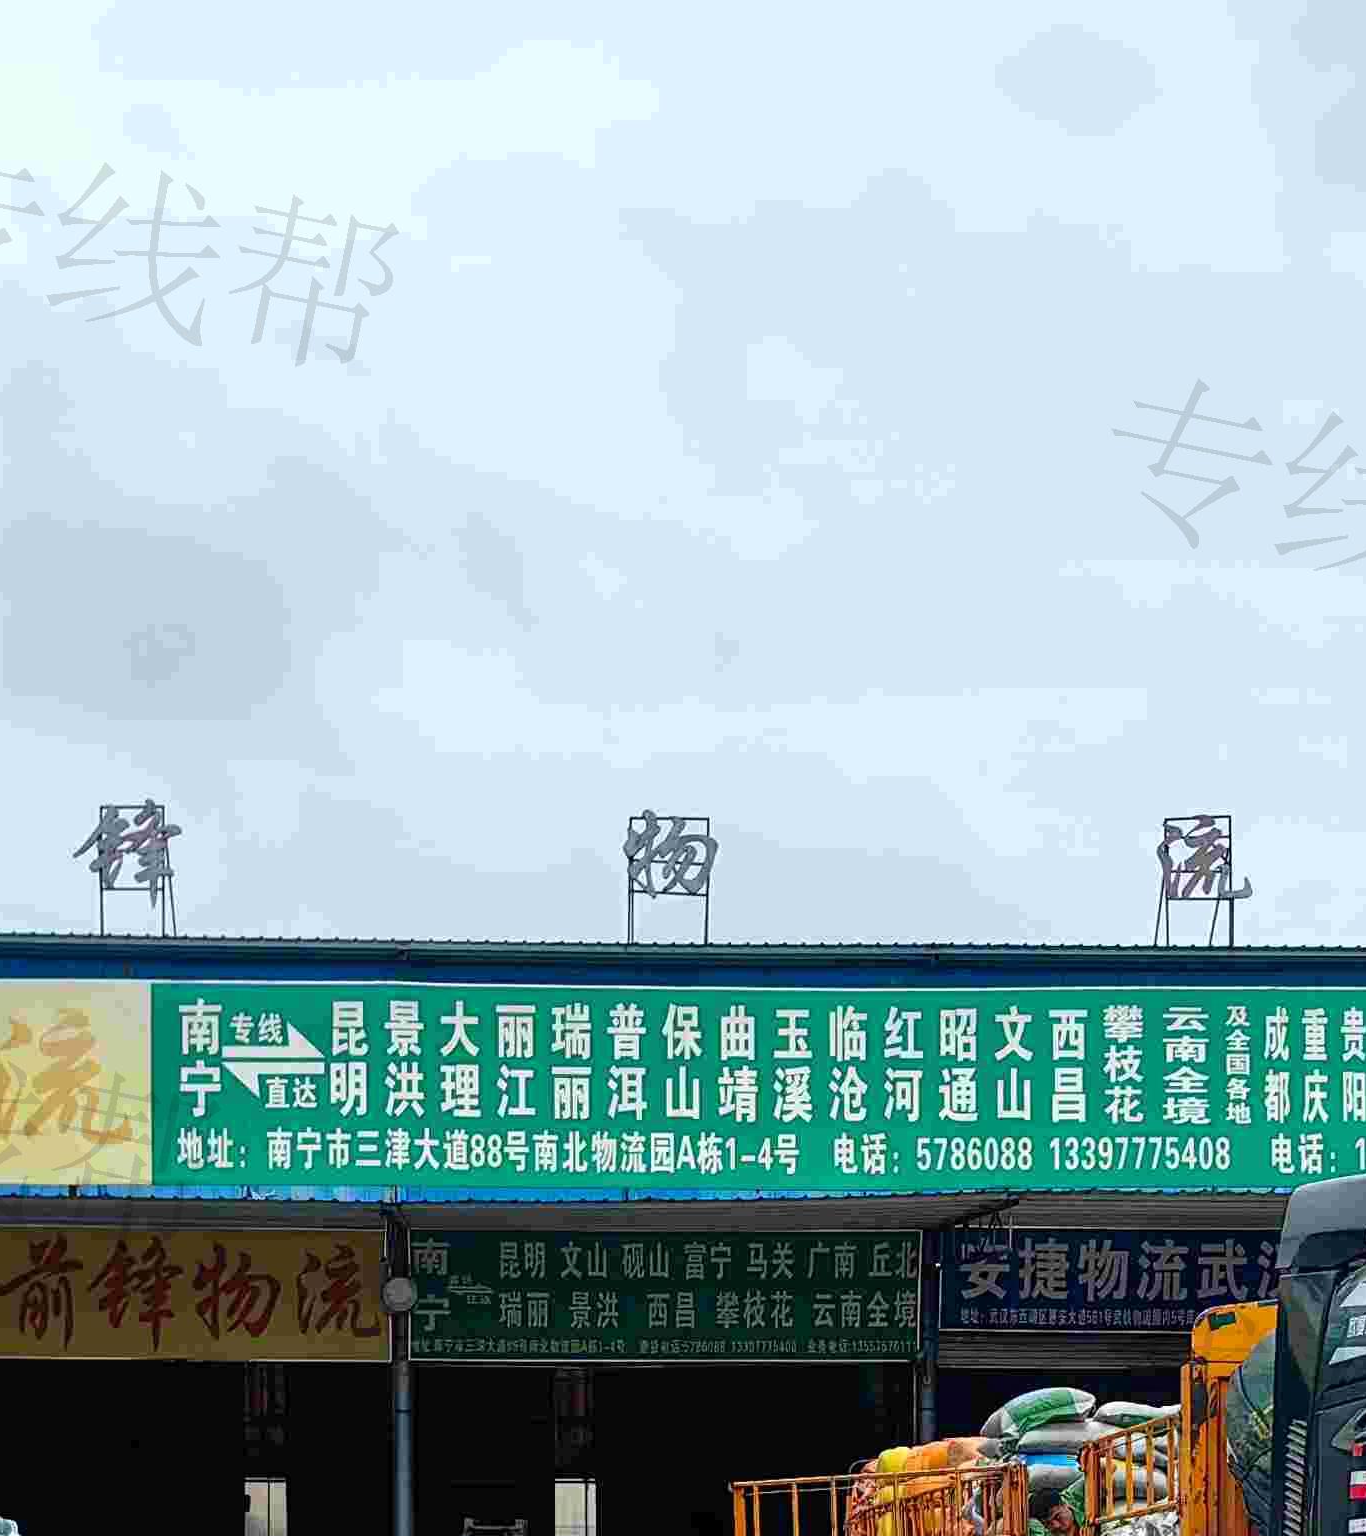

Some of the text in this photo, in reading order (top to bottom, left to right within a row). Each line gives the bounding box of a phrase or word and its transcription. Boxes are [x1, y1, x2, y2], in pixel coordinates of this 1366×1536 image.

[178, 998, 222, 1117] 南宁
[229, 1012, 284, 1044] 专线
[330, 1001, 368, 1115] 昆明
[384, 1000, 425, 1117] 景洪
[440, 1001, 482, 1117] 大理
[495, 1004, 537, 1116] 丽江
[551, 1003, 592, 1120] 瑞丽
[606, 1003, 647, 1121] 普洱
[661, 1004, 702, 1120] 保山
[718, 1005, 758, 1122] 曲靖
[772, 1008, 813, 1122] 玉溪
[828, 1006, 868, 1122] 临沧
[883, 1007, 924, 1122] 红河
[938, 1008, 978, 1122] 昭通
[993, 1006, 1033, 1121] 文山
[1049, 1010, 1087, 1122] 西昌
[1103, 1005, 1144, 1122] 攀枝花
[1162, 1006, 1210, 1124] 云南全境
[1225, 1005, 1252, 1124] 及全国各地
[1264, 1006, 1291, 1123] 成都
[1301, 1007, 1329, 1122] 重庆
[1340, 1006, 1366, 1121] 贵阳
[264, 1076, 317, 1109] 直达
[1050, 1136, 1231, 1171] 13397775408
[498, 1240, 546, 1279] 昆明
[560, 1240, 608, 1279] 文山
[684, 1241, 732, 1280] 富宁
[746, 1241, 794, 1279] 马关
[806, 1241, 858, 1279] 广南
[867, 1241, 918, 1280] 丘北
[498, 1290, 918, 1329] 瑞丽 景洪 西昌 攀枝花 云南全境
[960, 1237, 1280, 1300] 安捷物流武
